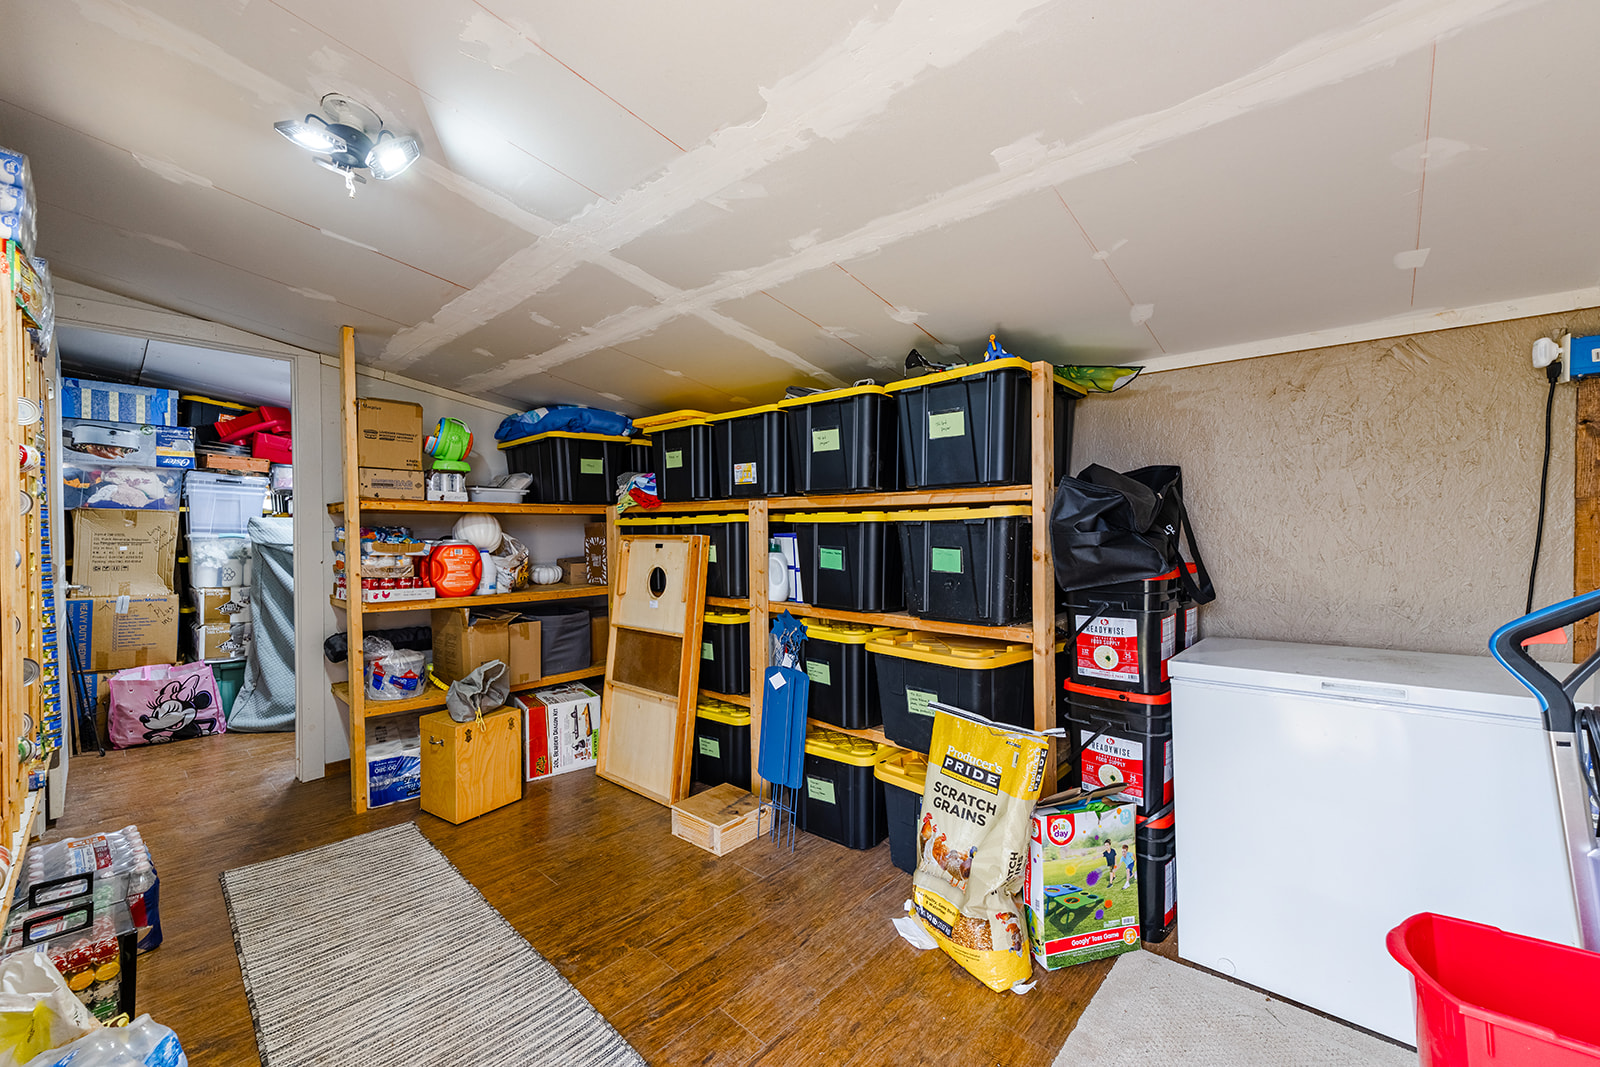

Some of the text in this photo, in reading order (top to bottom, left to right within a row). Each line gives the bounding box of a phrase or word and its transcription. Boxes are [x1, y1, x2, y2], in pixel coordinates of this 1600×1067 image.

[163, 458, 190, 467] Oster
[79, 602, 88, 624] HEAVY
[79, 625, 88, 642] DUTY
[946, 745, 1002, 774] Producer's
[944, 757, 999, 786] PRIDE
[933, 781, 997, 816] SCRATCH
[933, 797, 986, 827] GRAINS
[1054, 830, 1068, 838] day
[1103, 931, 1119, 939] Game
[1126, 934, 1135, 942] 5+
